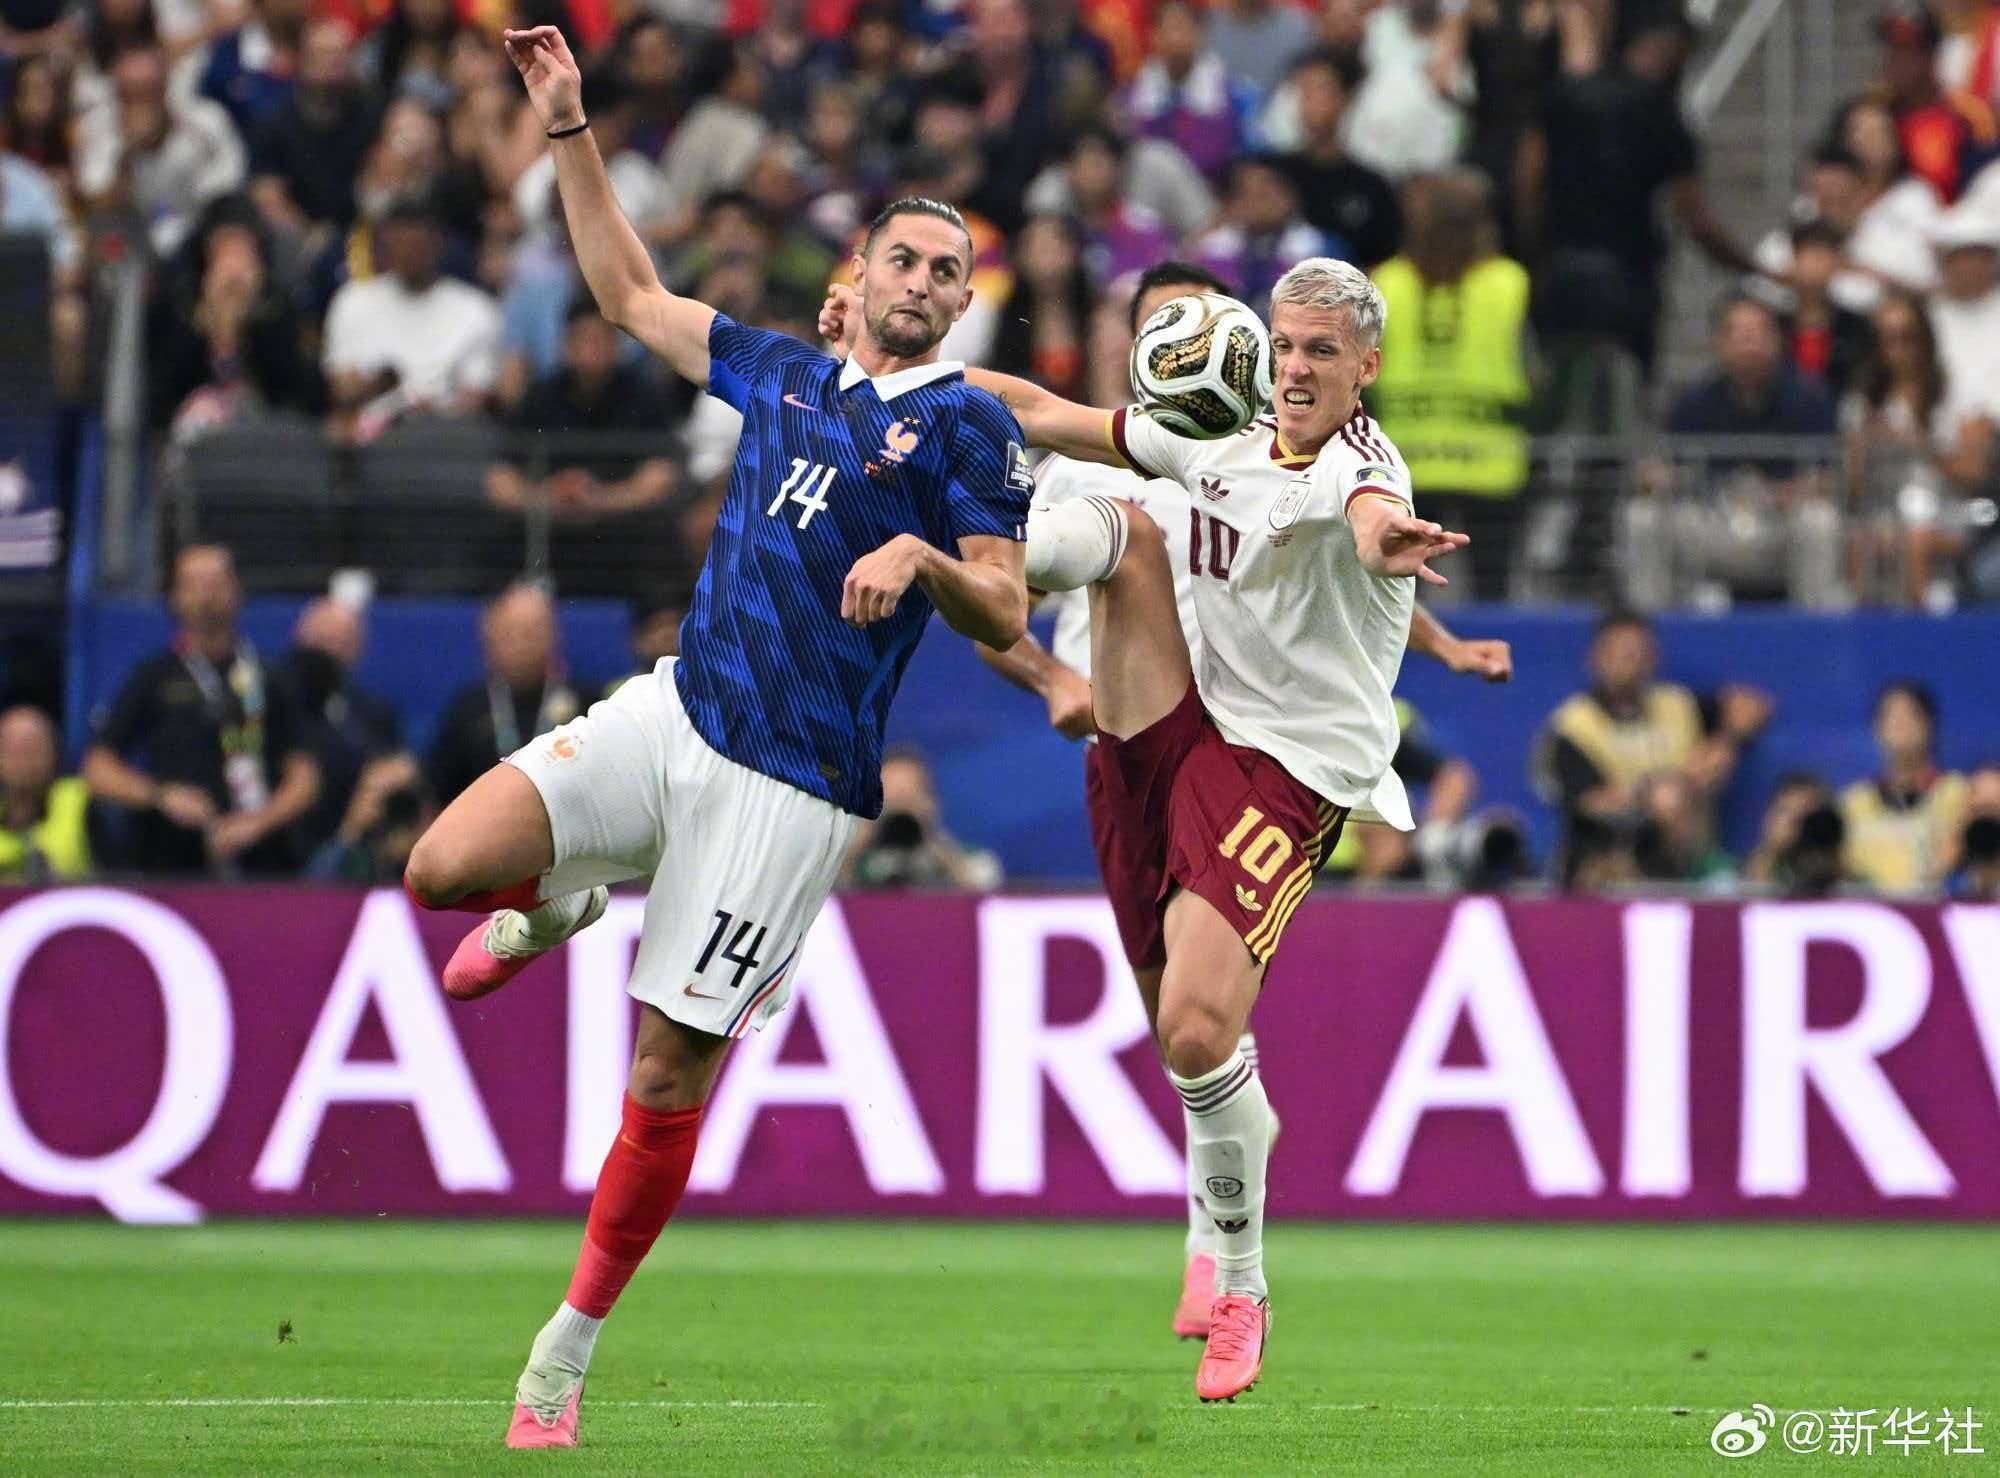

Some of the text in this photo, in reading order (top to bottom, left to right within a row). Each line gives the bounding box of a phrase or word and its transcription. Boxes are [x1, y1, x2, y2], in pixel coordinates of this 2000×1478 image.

[767, 457, 838, 529] 14
[1190, 505, 1240, 581] 10
[1218, 806, 1293, 884] 10
[694, 909, 767, 988] 14
[1344, 895, 2000, 1198] AIR
